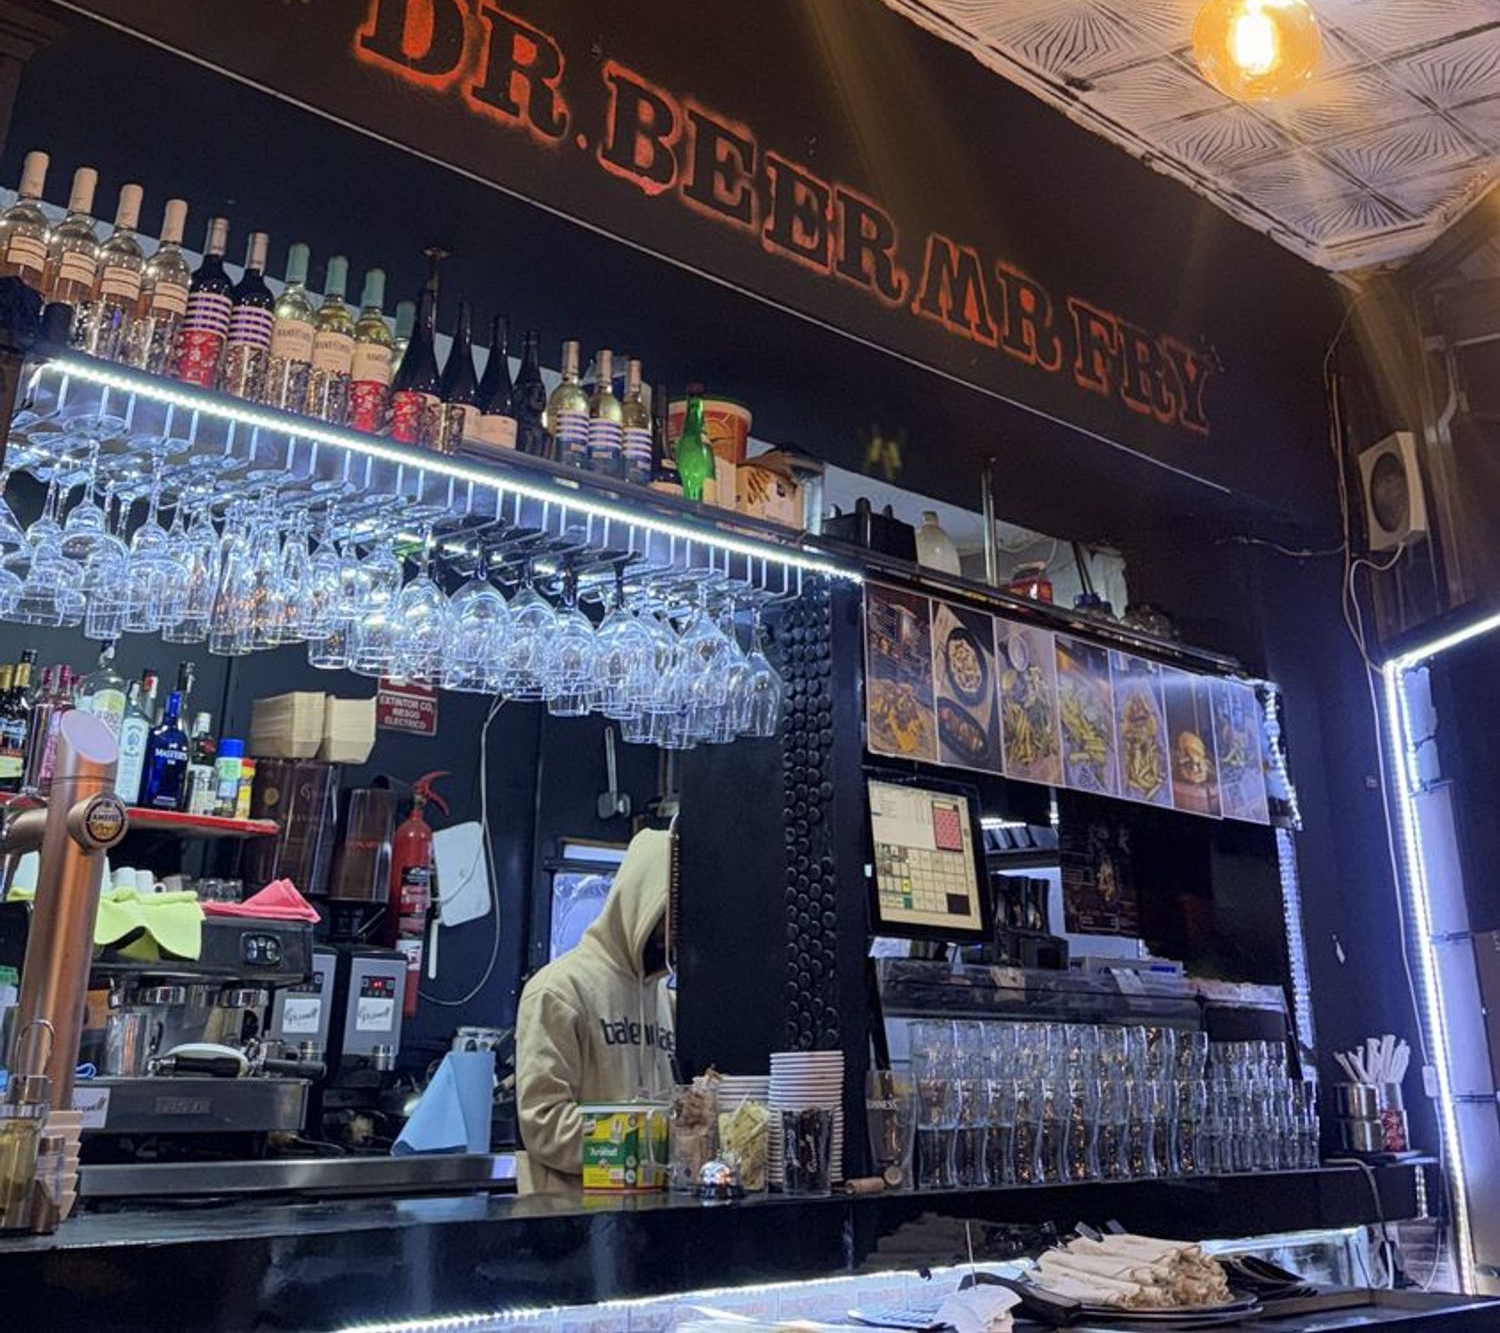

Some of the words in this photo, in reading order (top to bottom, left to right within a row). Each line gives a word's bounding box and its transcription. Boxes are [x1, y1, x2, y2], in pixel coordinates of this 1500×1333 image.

[597, 60, 909, 307] BEER
[911, 232, 1062, 371] MR
[1067, 297, 1209, 434] FRY
